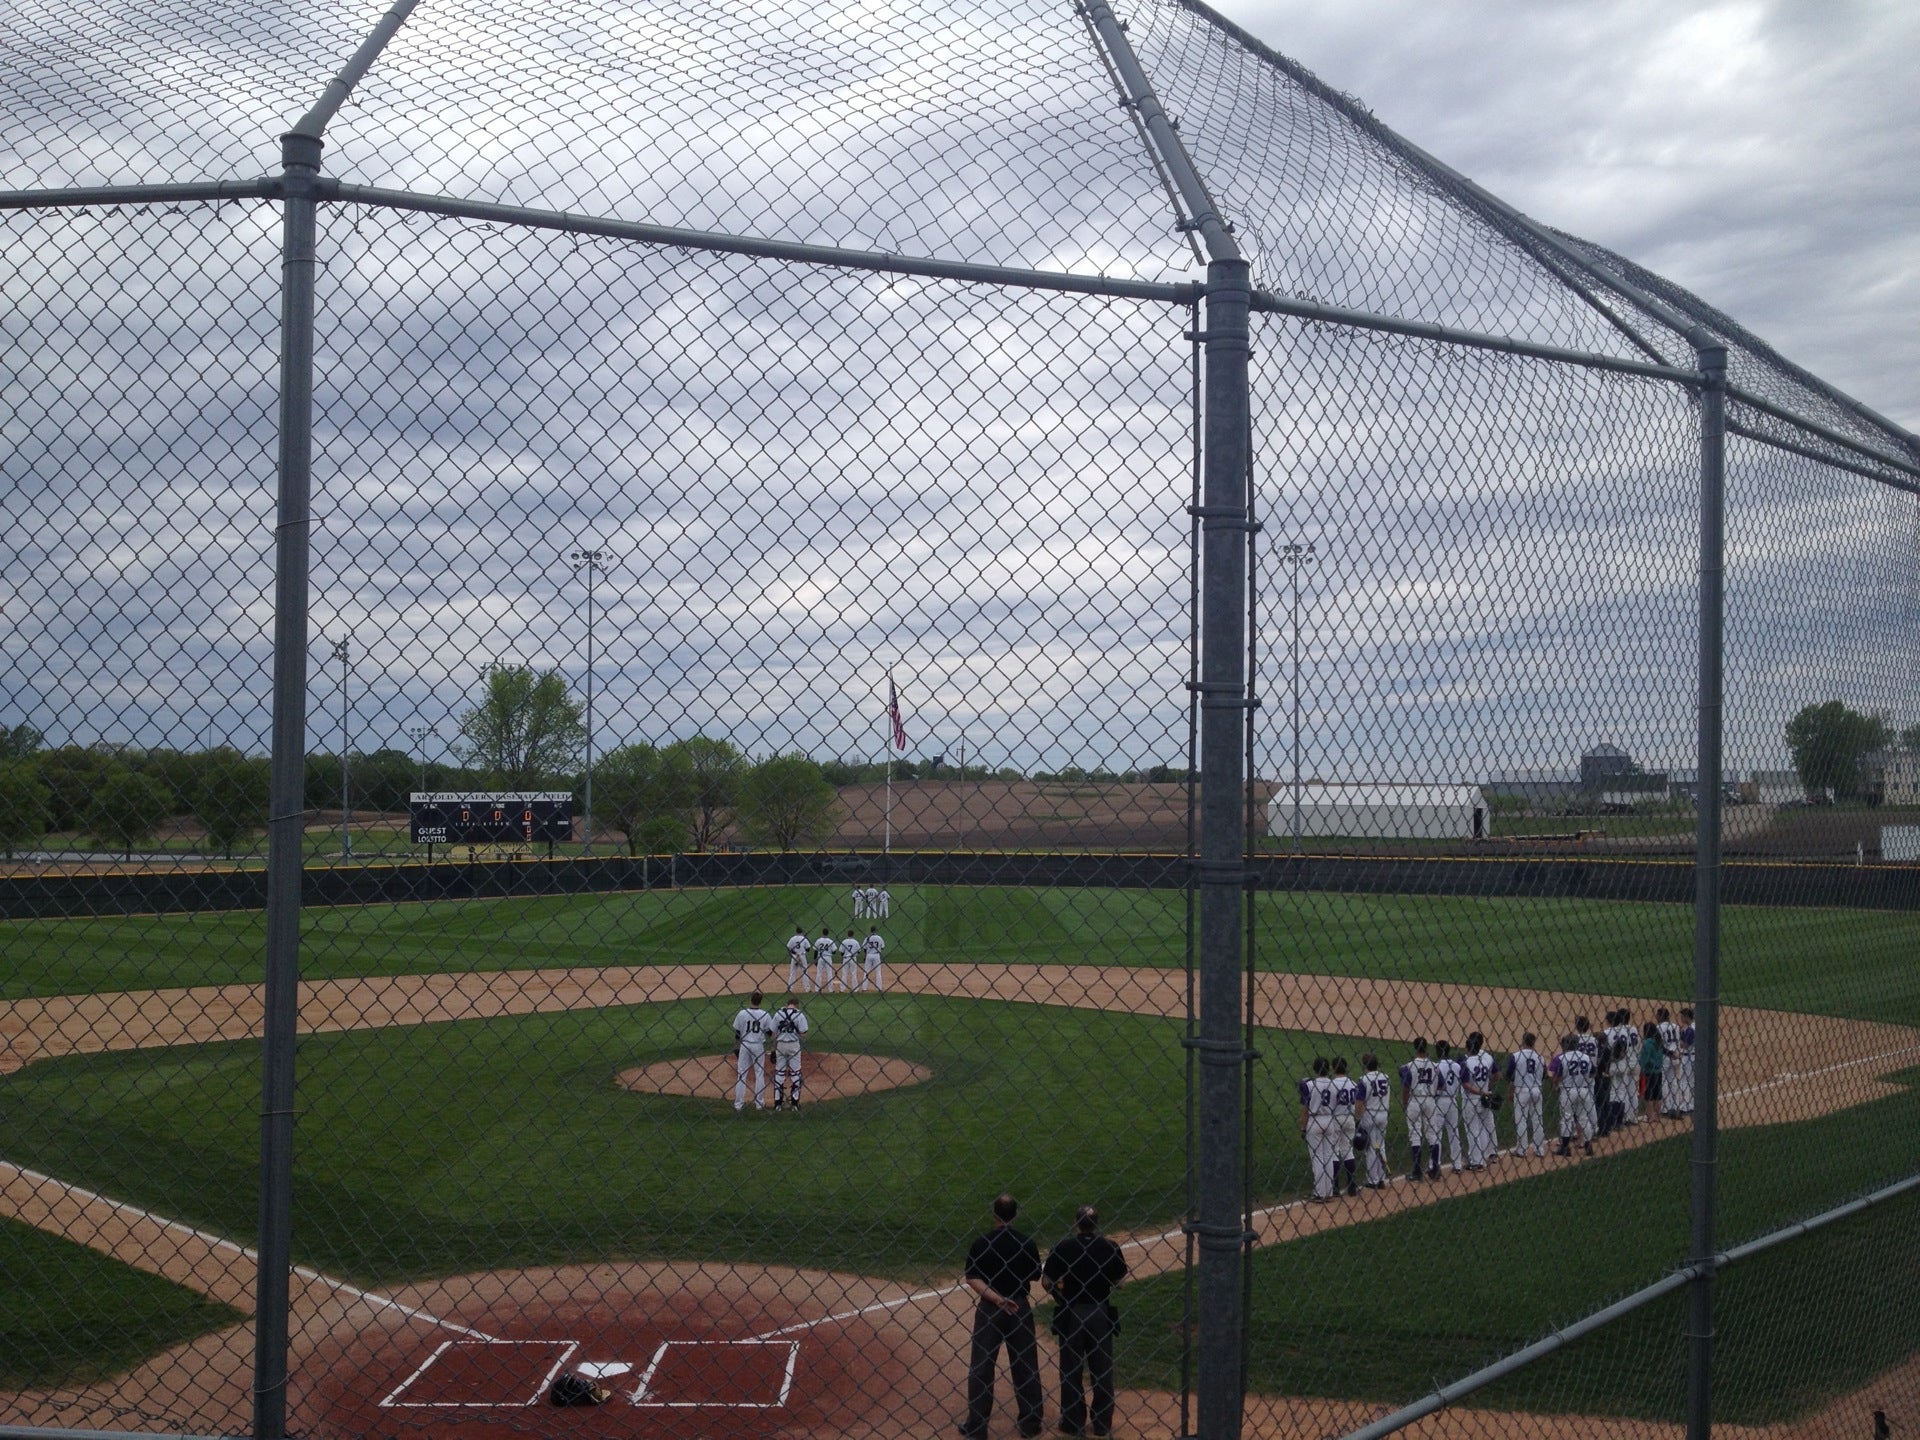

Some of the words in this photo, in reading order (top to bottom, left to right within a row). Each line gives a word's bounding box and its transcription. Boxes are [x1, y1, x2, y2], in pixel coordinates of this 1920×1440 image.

[418, 827, 446, 835] GUEST
[819, 943, 829, 951] 24
[746, 1020, 760, 1033] 10
[1568, 1060, 1588, 1076] 29
[1371, 1079, 1388, 1097] 15
